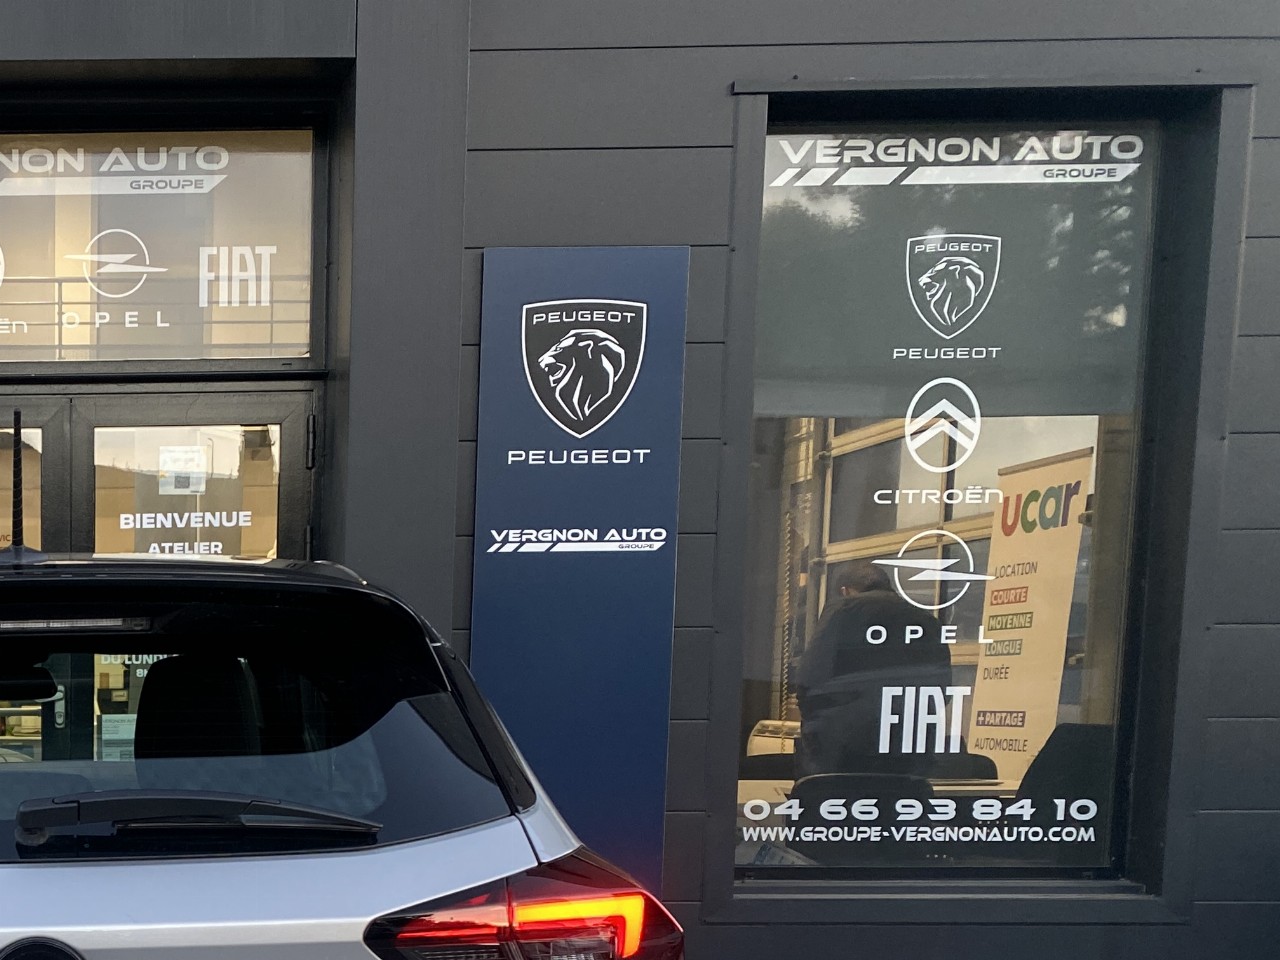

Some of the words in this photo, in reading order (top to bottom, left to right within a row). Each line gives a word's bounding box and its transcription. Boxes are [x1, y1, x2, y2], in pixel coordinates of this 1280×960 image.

[779, 136, 1000, 164] VERGNON
[1013, 135, 1144, 161] AUTO
[98, 146, 230, 173] AUTO
[1043, 167, 1118, 179] GROUPE
[129, 179, 205, 191] GROUPE
[914, 242, 993, 254] PEUGEOT
[198, 245, 277, 308] FIAT
[61, 310, 170, 330] OPEL
[532, 310, 636, 325] PEUGEOT
[892, 346, 1002, 360] PEUGEOT
[507, 449, 651, 465] PEUGEOT
[1001, 480, 1082, 537] ucar
[120, 511, 252, 529] BIENVENUE
[490, 528, 598, 542] VERGNON
[604, 527, 667, 541] AUTO
[148, 542, 223, 554] ATELIER
[995, 561, 1038, 579] LOCATION
[991, 588, 1028, 605] COURTE
[989, 613, 1032, 630] MOYENNE
[866, 625, 994, 645] OPEL
[986, 639, 1022, 655] LONGUE
[983, 664, 1010, 680] DURÉE
[878, 686, 971, 754] FIAT
[974, 738, 1028, 753] AUTOMOBILE
[743, 799, 805, 821] 04
[820, 799, 880, 821] 66
[894, 799, 957, 821] 93
[972, 799, 1036, 821] 84
[1052, 798, 1098, 820] 10
[742, 825, 1096, 843] WWW.GROUPE-VERGNONAUTO.COM
